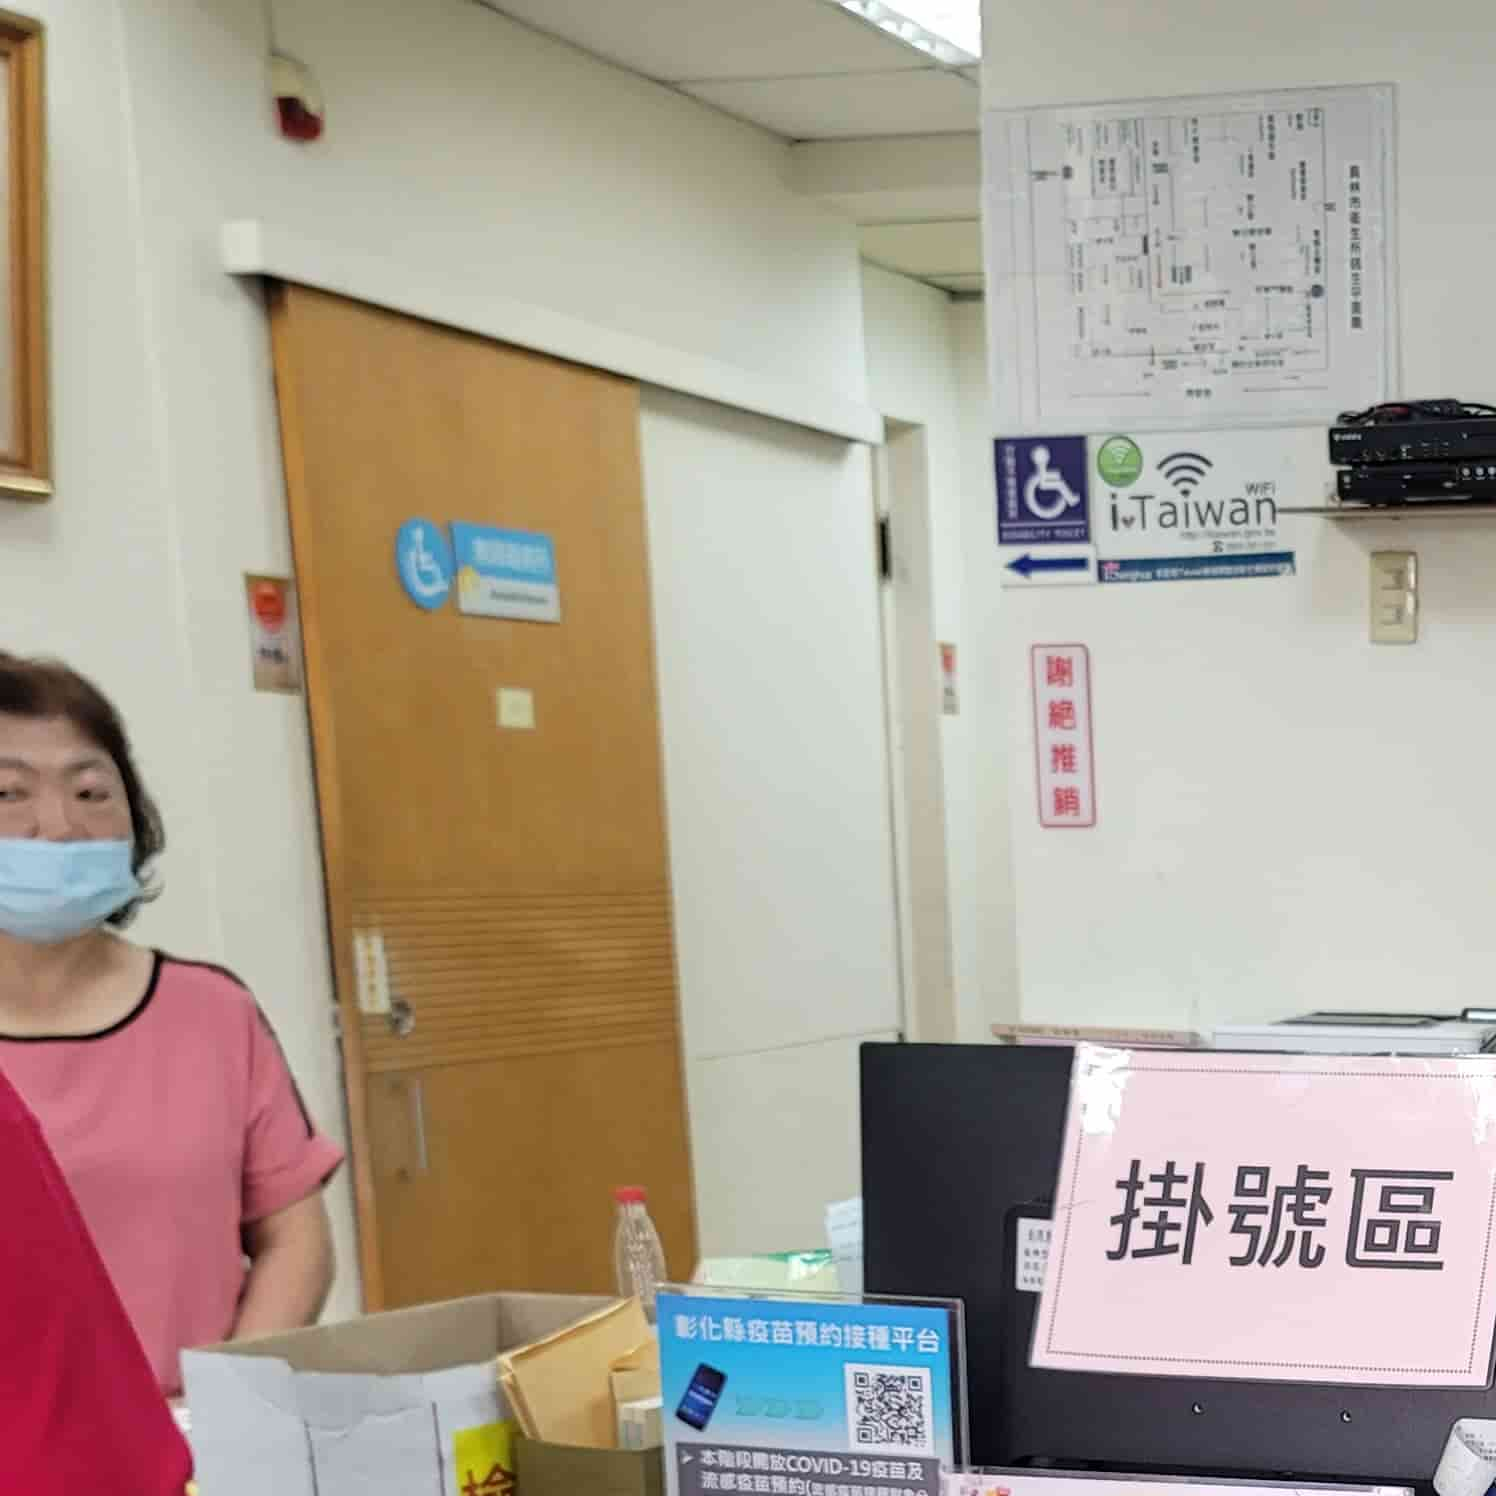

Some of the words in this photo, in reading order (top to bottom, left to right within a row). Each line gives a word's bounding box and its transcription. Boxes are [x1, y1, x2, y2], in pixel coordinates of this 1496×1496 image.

[1046, 654, 1081, 818] 謝絕推銷
[1106, 1159, 1455, 1271] 掛號區
[674, 1314, 939, 1353] 彰化縣疫苗預約接種平台
